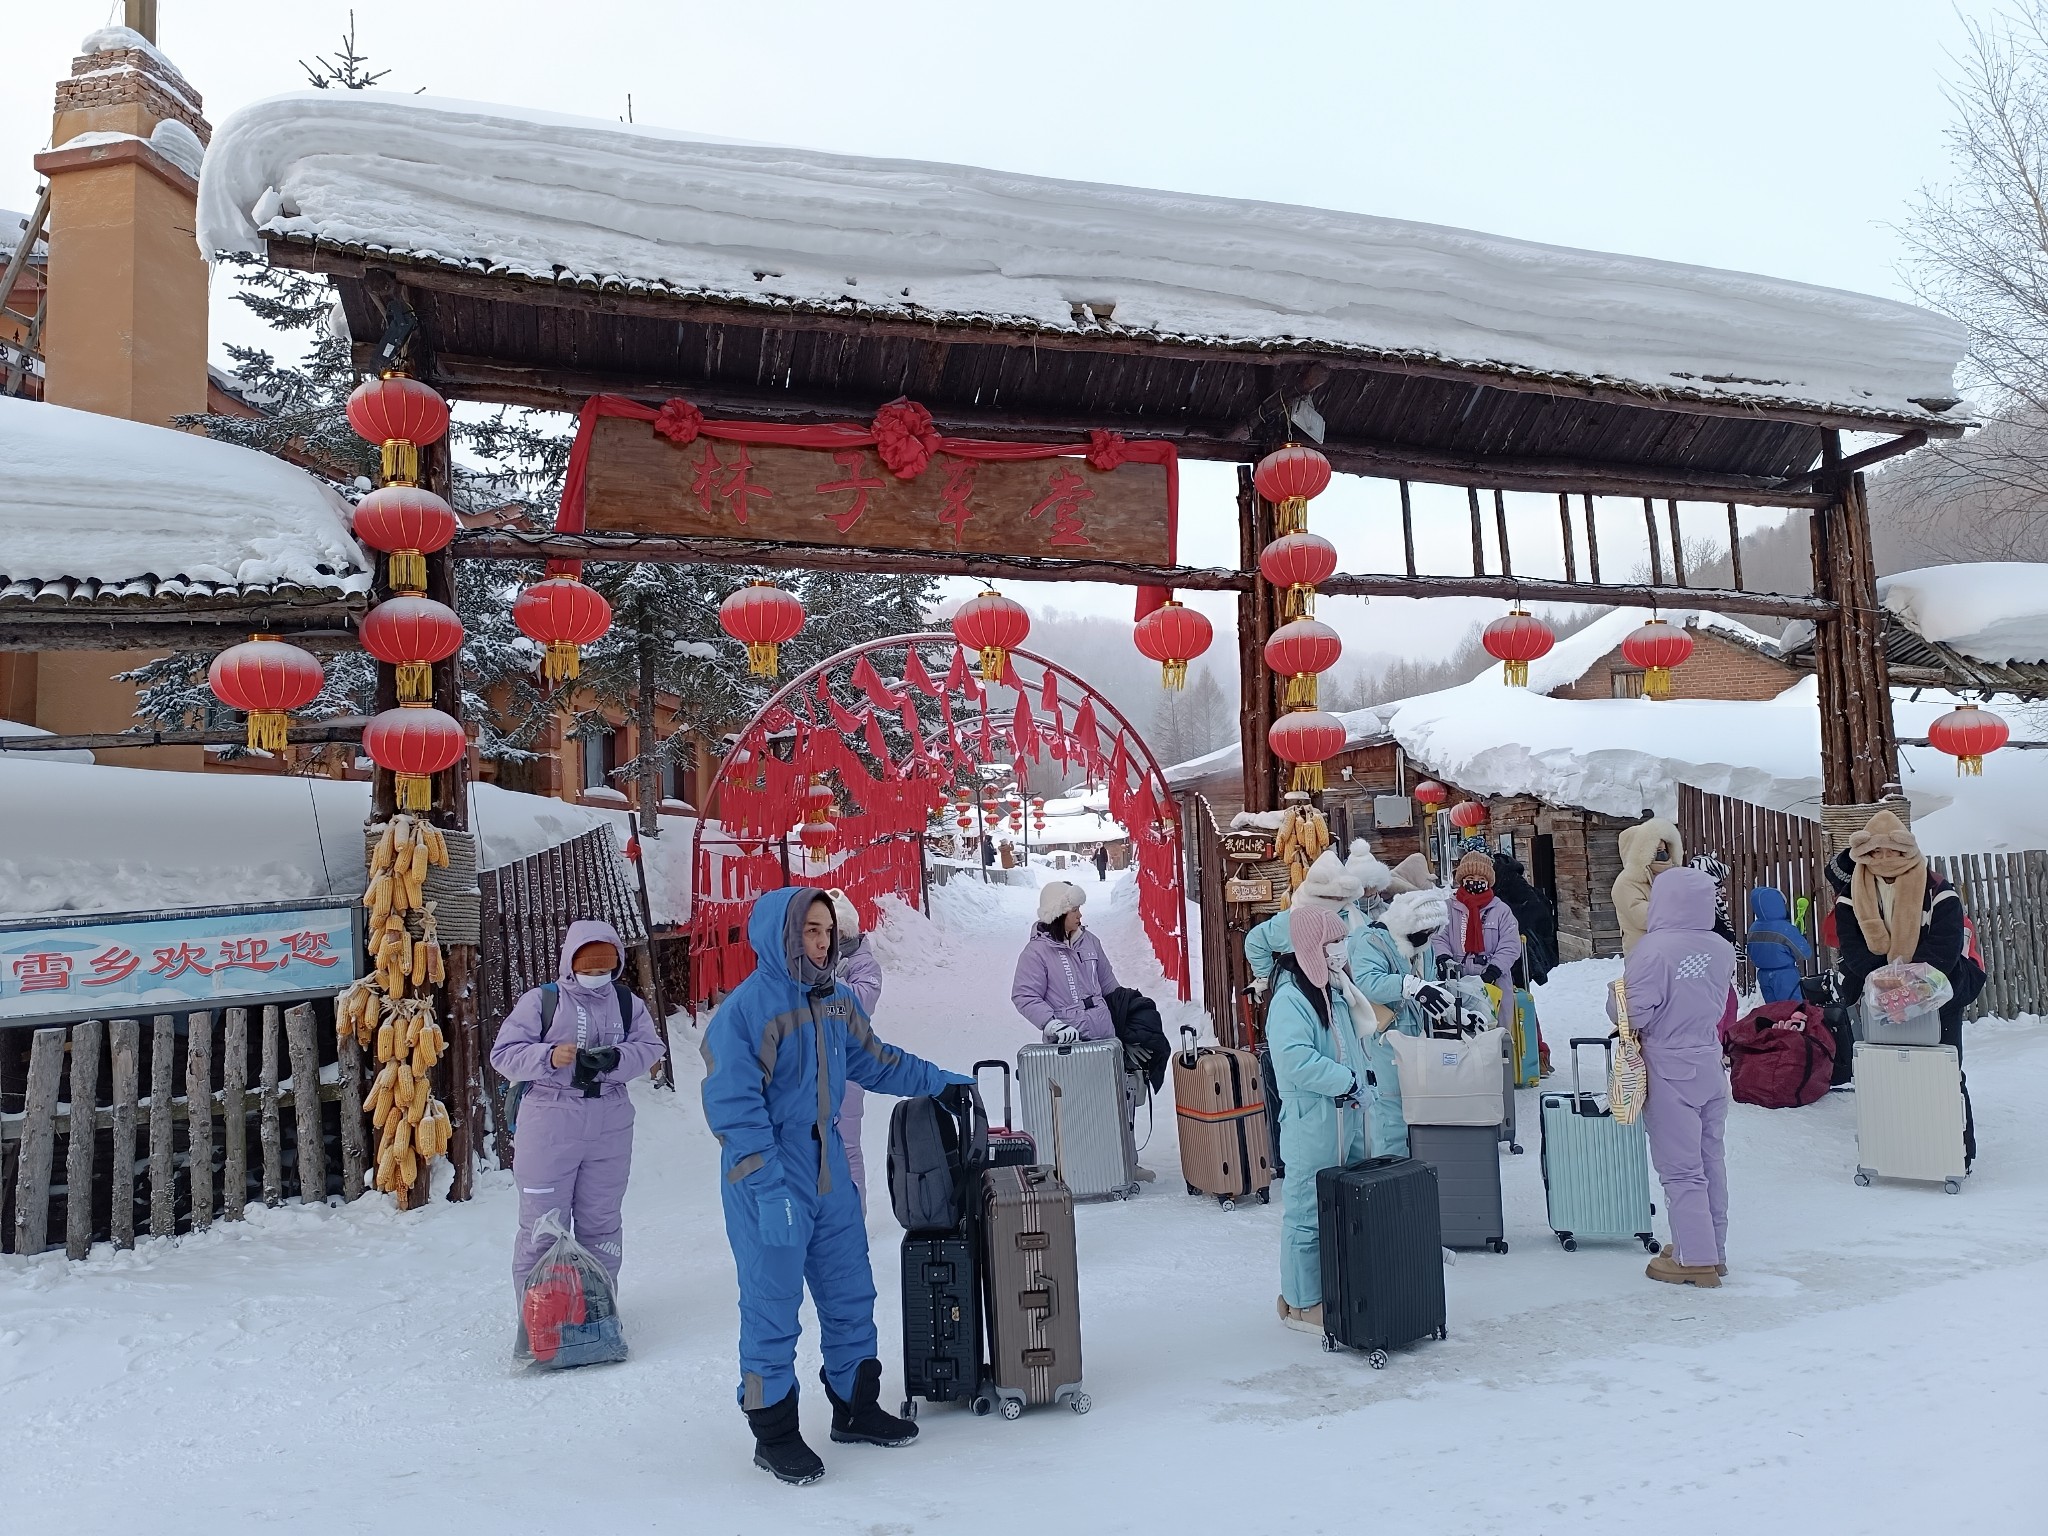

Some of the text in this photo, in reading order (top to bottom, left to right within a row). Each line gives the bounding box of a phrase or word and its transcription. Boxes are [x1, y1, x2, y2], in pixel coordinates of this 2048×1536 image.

[12, 931, 340, 993] 雪乡欢迎您
